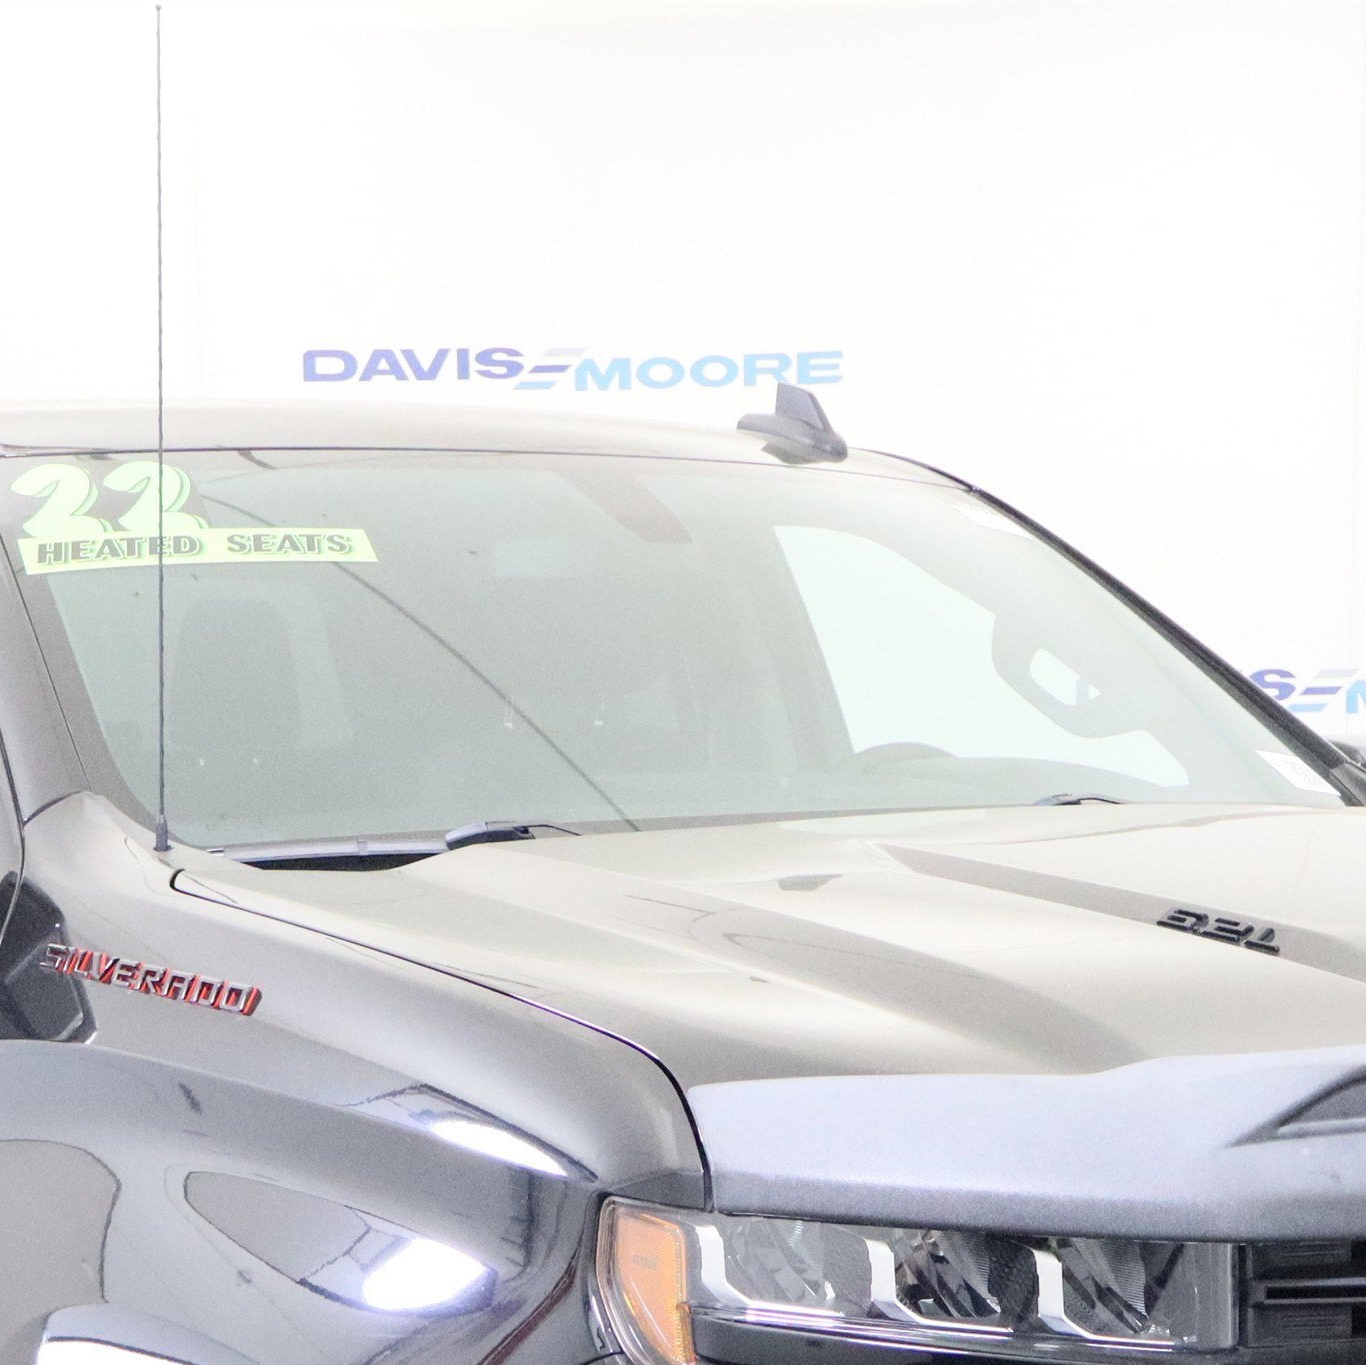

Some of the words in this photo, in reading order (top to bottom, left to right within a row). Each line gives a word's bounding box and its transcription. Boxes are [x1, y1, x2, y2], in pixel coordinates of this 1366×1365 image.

[302, 347, 525, 383] DAVIS
[573, 350, 844, 392] MOORE
[10, 460, 210, 537] 22
[37, 533, 201, 566] HEATED
[226, 532, 353, 556] SEATS
[39, 942, 262, 1016] SILVERADO
